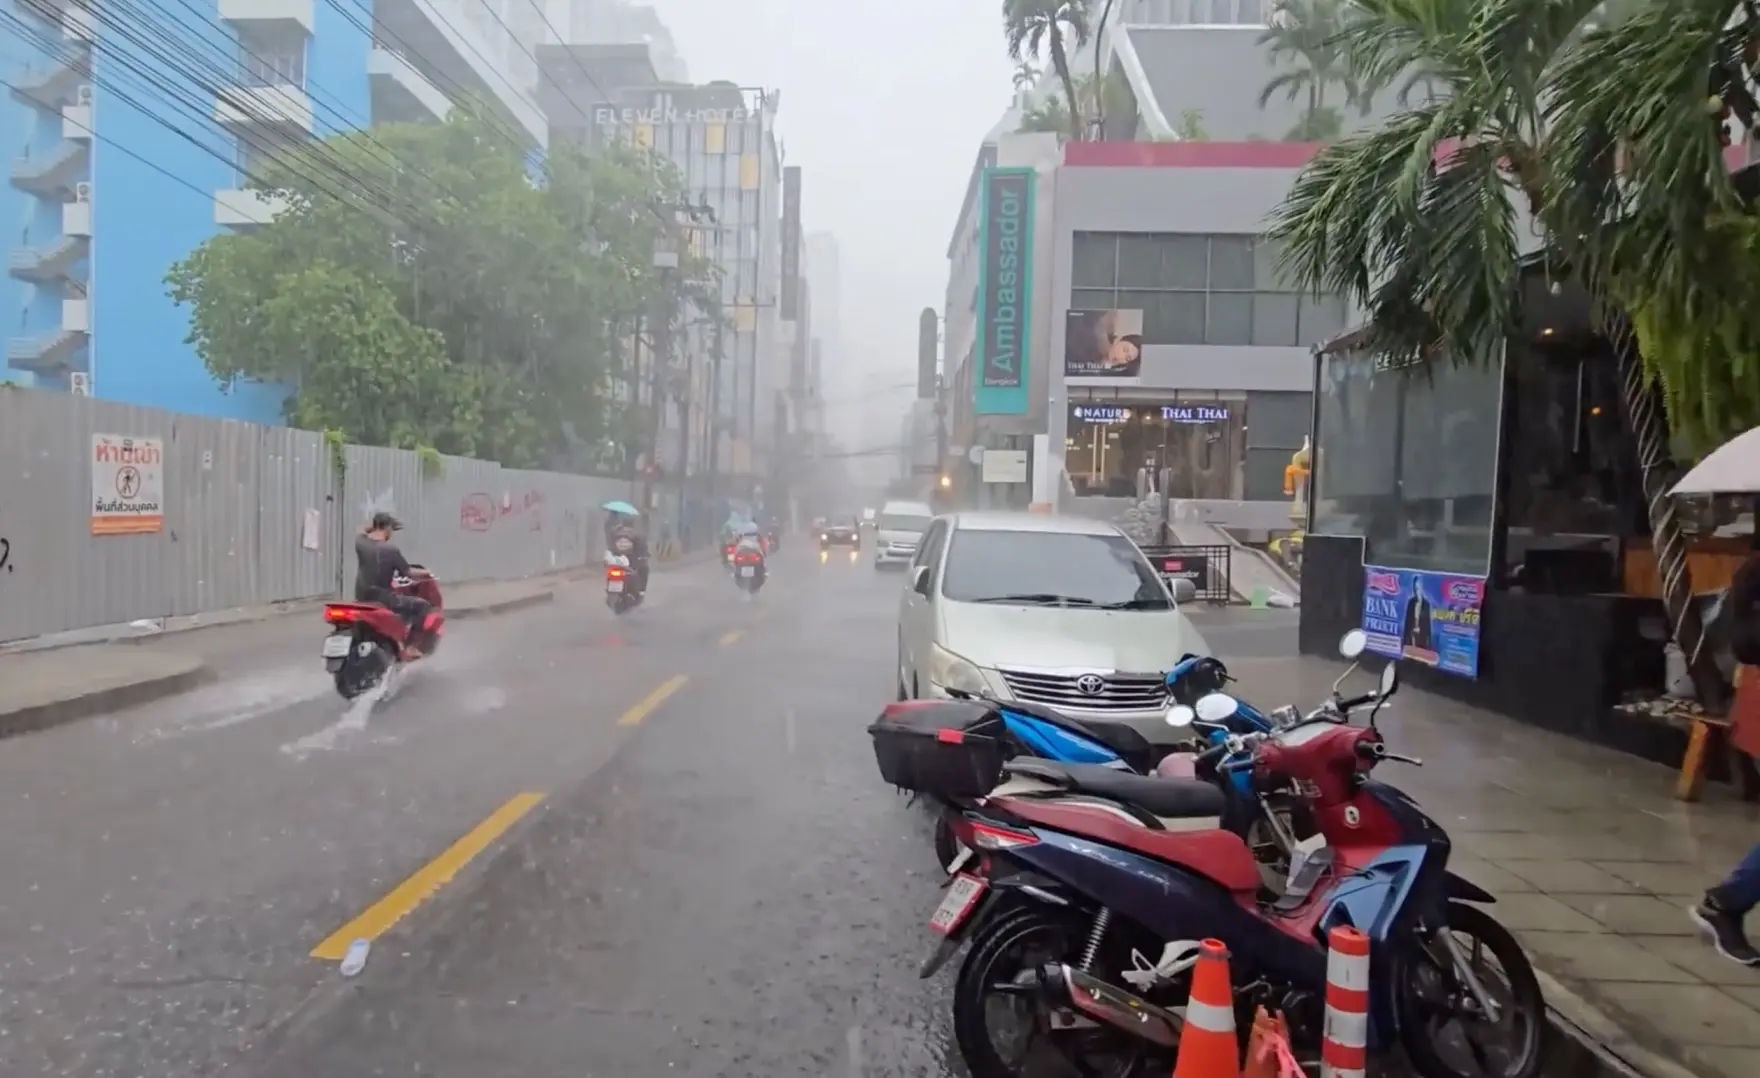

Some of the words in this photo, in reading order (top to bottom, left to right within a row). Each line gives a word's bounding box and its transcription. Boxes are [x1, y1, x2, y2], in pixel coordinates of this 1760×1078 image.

[595, 107, 678, 125] ELEVEN
[990, 189, 1020, 373] Ambassador
[1161, 407, 1193, 420] THAI
[1197, 407, 1228, 420] THAI
[1366, 597, 1398, 618] BANK
